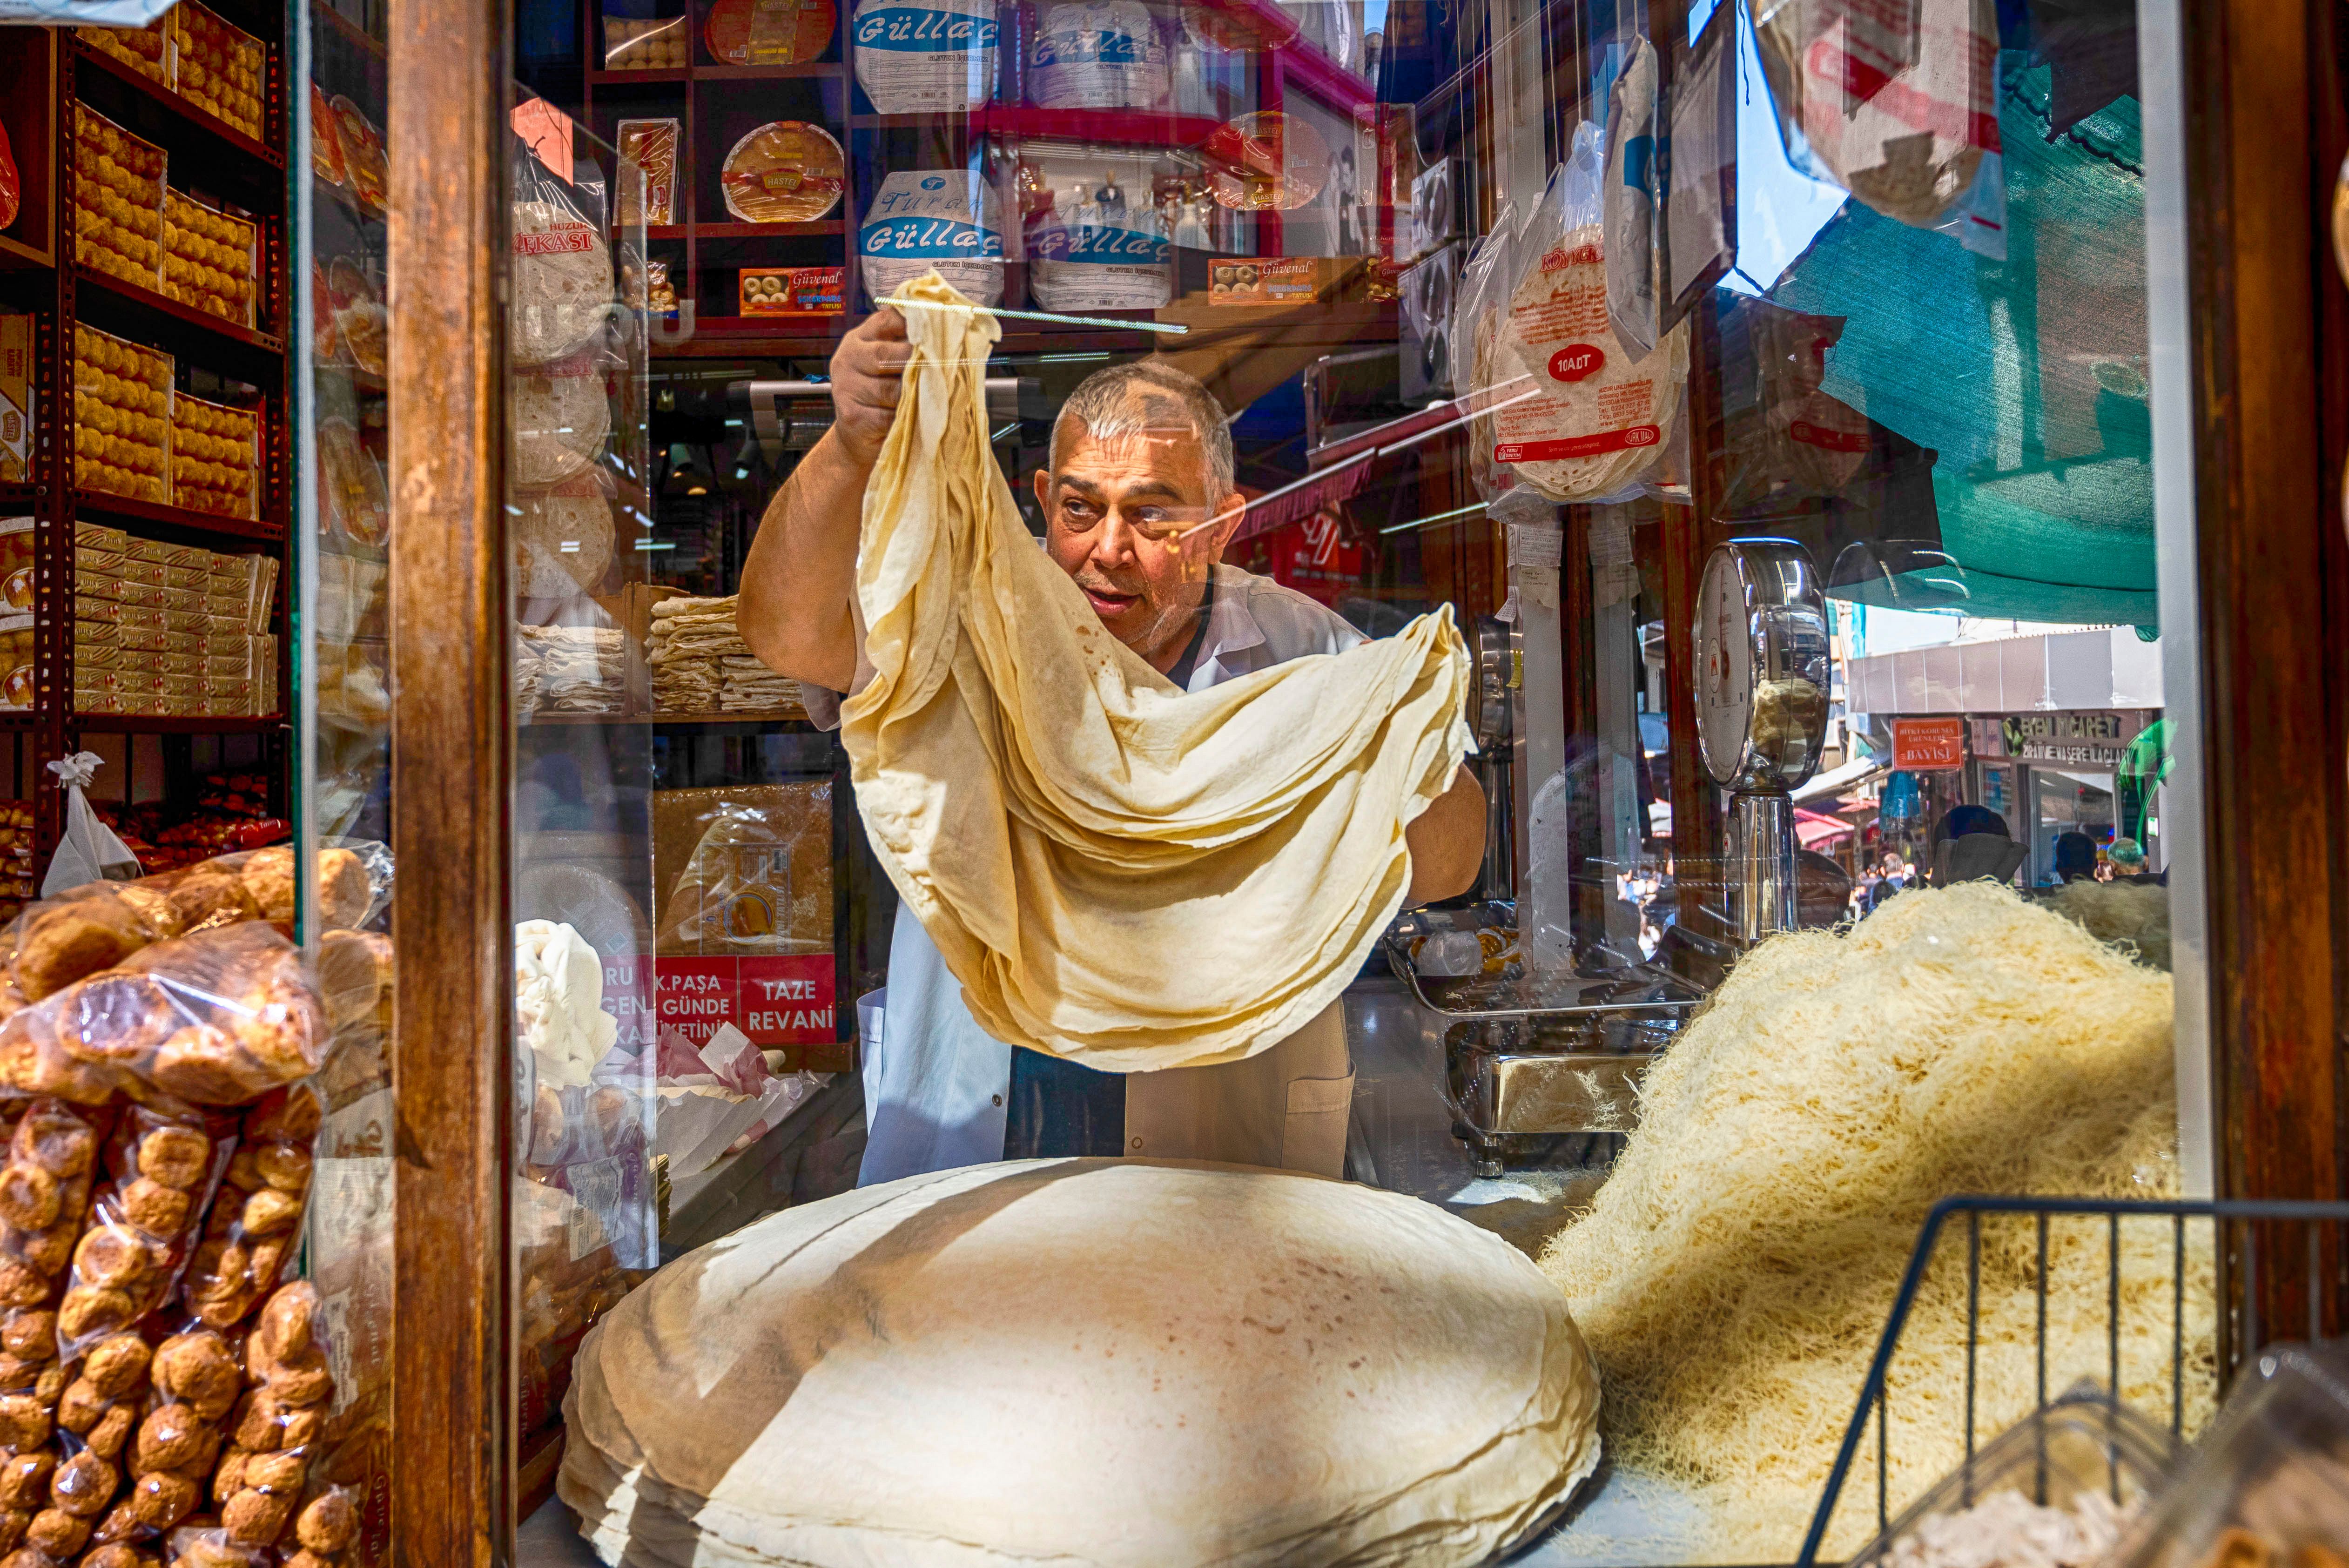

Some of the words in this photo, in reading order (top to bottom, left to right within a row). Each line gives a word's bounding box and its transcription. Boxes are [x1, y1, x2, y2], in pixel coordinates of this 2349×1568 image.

[859, 13, 998, 46] Güllaç
[957, 54, 989, 63] İÇERMEZ
[768, 178, 798, 186] HASTEL
[881, 190, 983, 214] Turan
[867, 221, 1002, 256] Güllaç
[1037, 229, 1171, 262] Güllaç
[962, 261, 993, 271] İÇERMEZ
[1134, 267, 1166, 277] İÇERMEZ
[1263, 261, 1311, 278] Güvenal
[793, 272, 841, 288] Güvenal
[1907, 747, 1951, 760] BAYİSİ
[656, 975, 721, 994] K.PAŞA
[763, 980, 816, 1001] TAZE
[663, 996, 729, 1015] GÜNDE
[749, 1004, 834, 1030] REVANİ
